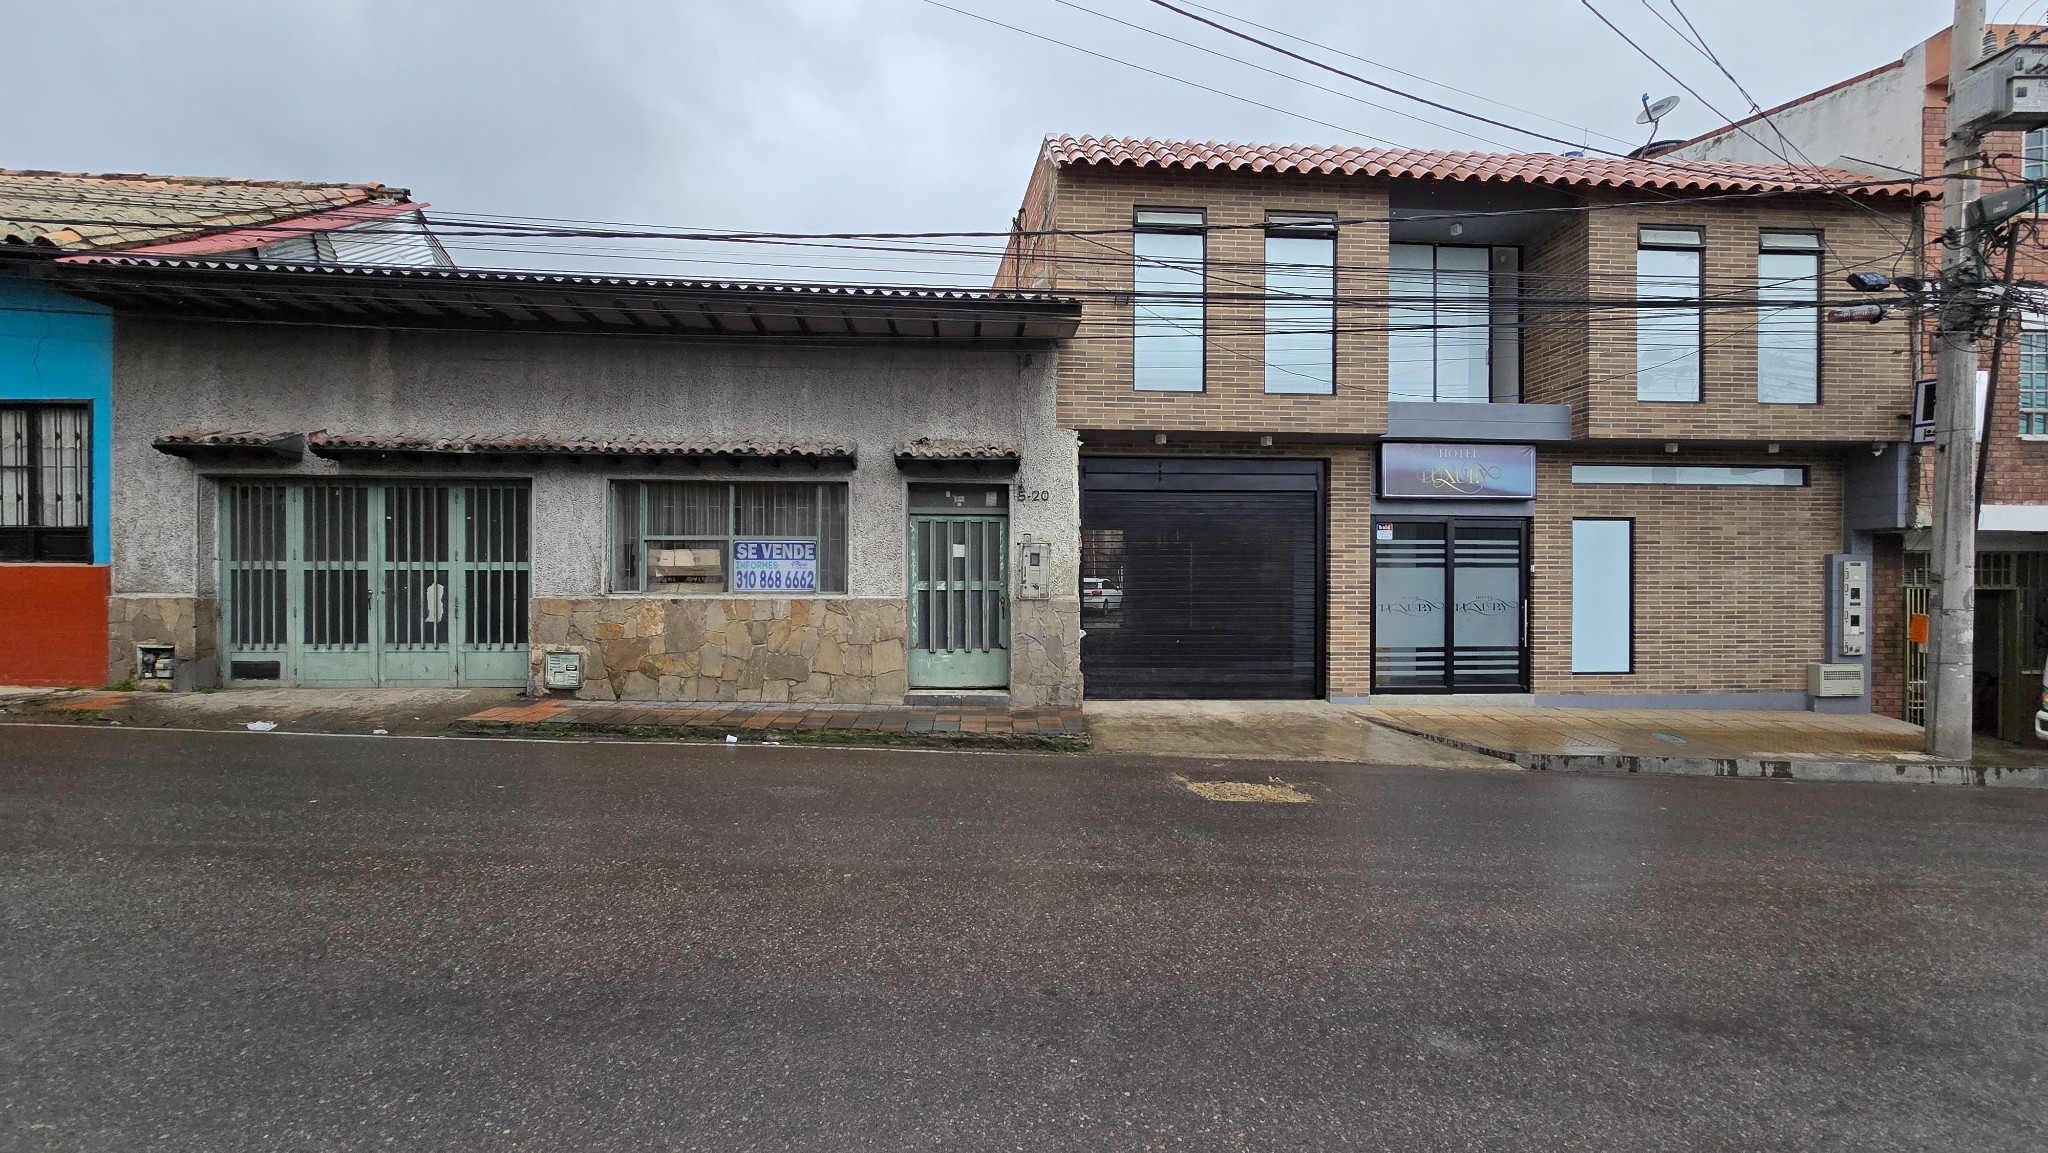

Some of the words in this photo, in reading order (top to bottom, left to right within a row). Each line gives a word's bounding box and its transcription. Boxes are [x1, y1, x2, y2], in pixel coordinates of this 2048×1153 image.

[1438, 448, 1481, 458] HOTEL
[1417, 462, 1501, 494] LUXURY
[1018, 490, 1049, 502] 5-20
[736, 543, 758, 560] SE
[761, 543, 815, 560] VENDE
[735, 561, 780, 570] INFORMES:
[736, 570, 756, 589] 310
[759, 570, 782, 589] 868
[785, 570, 815, 589] 6662
